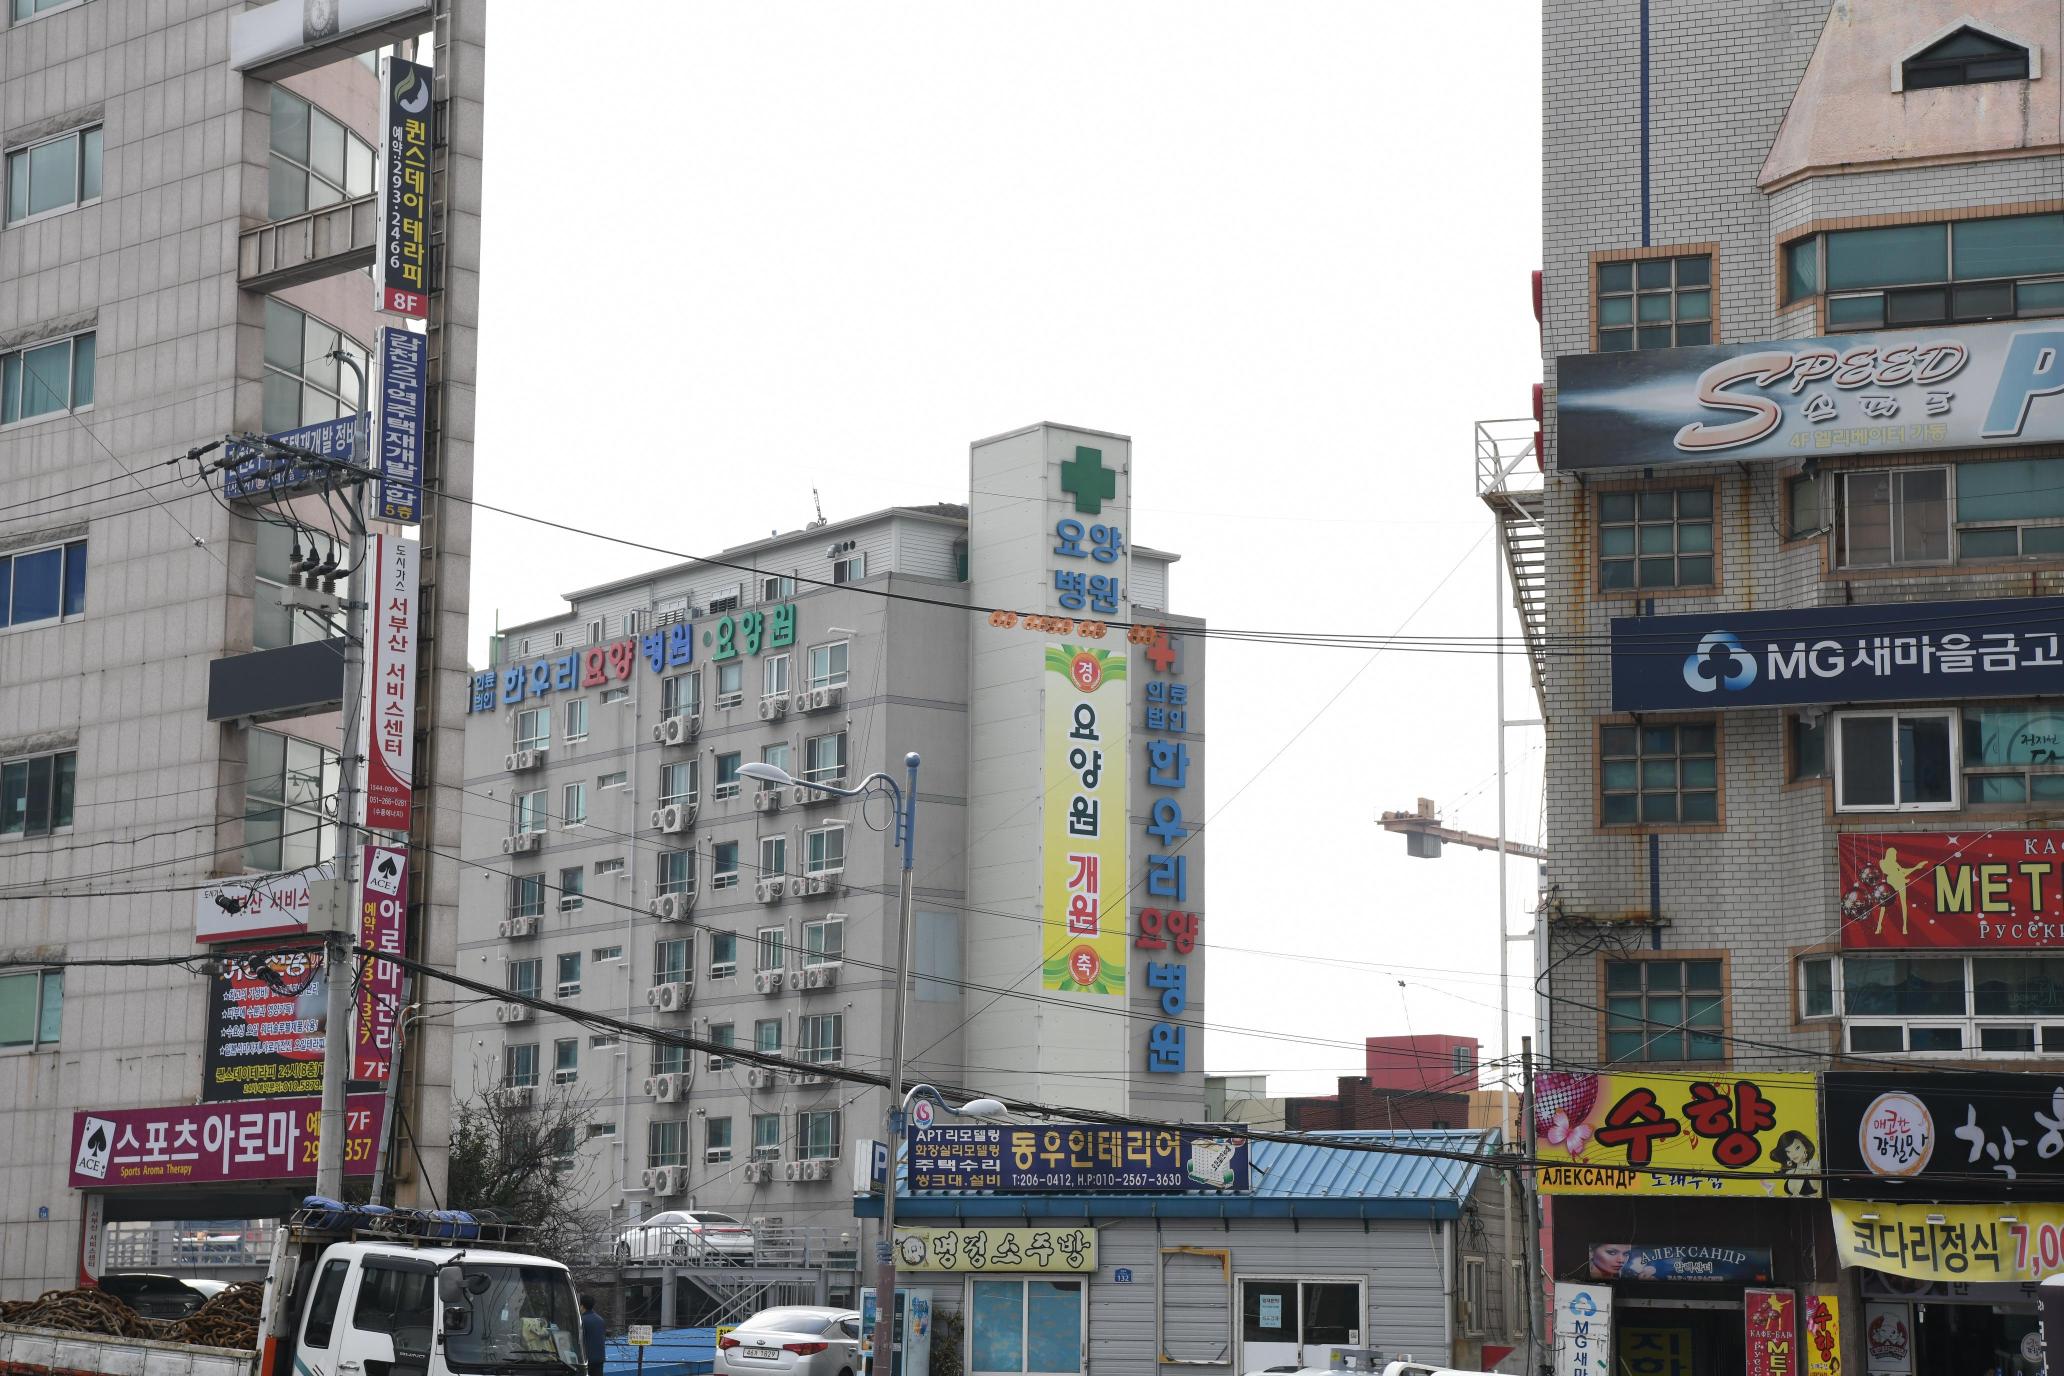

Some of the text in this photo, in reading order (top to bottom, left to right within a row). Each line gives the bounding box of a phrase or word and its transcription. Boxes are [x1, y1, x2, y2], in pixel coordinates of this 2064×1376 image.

[403, 118, 425, 289] 퀸스데이테라피
[393, 293, 417, 312] 8F
[1674, 338, 1971, 452] SPEED
[1802, 391, 1954, 423] 스피드
[1790, 431, 1811, 449] 4F
[1911, 422, 1948, 442] 가동
[385, 503, 413, 519] 5층
[1054, 518, 1122, 563] 요양
[396, 545, 406, 592] 도시가스
[1055, 569, 1119, 614] 병원
[711, 602, 798, 662] 요양원
[384, 597, 409, 757] 서부산 서비스센터
[1145, 680, 1188, 706] 의료
[1145, 706, 1188, 734] 법인
[1068, 703, 1102, 938] 요양원 개원
[370, 877, 392, 890] ACE
[378, 899, 403, 988] 아로마
[375, 992, 400, 1049] 관리
[216, 1063, 277, 1083] 퀸스데이테라피
[363, 1061, 390, 1078] 7F
[347, 1110, 371, 1131] 7F
[1594, 1080, 1777, 1169] 수향
[916, 1129, 1000, 1142] APT 리모델링
[79, 1157, 100, 1172] ACE
[915, 1144, 1000, 1158] 화장실리모델링
[1011, 1130, 1181, 1171] 동우인테리어
[120, 1162, 192, 1178] Sports Aroma Therapy
[915, 1159, 1001, 1172] 주택수리
[1542, 1170, 1638, 1189] АЛЕКСАНДР
[1640, 1246, 1746, 1266] АЛЕКСАНДР
[1852, 1220, 2000, 1274] 코다리정식
[1814, 1302, 1835, 1363] 수향
